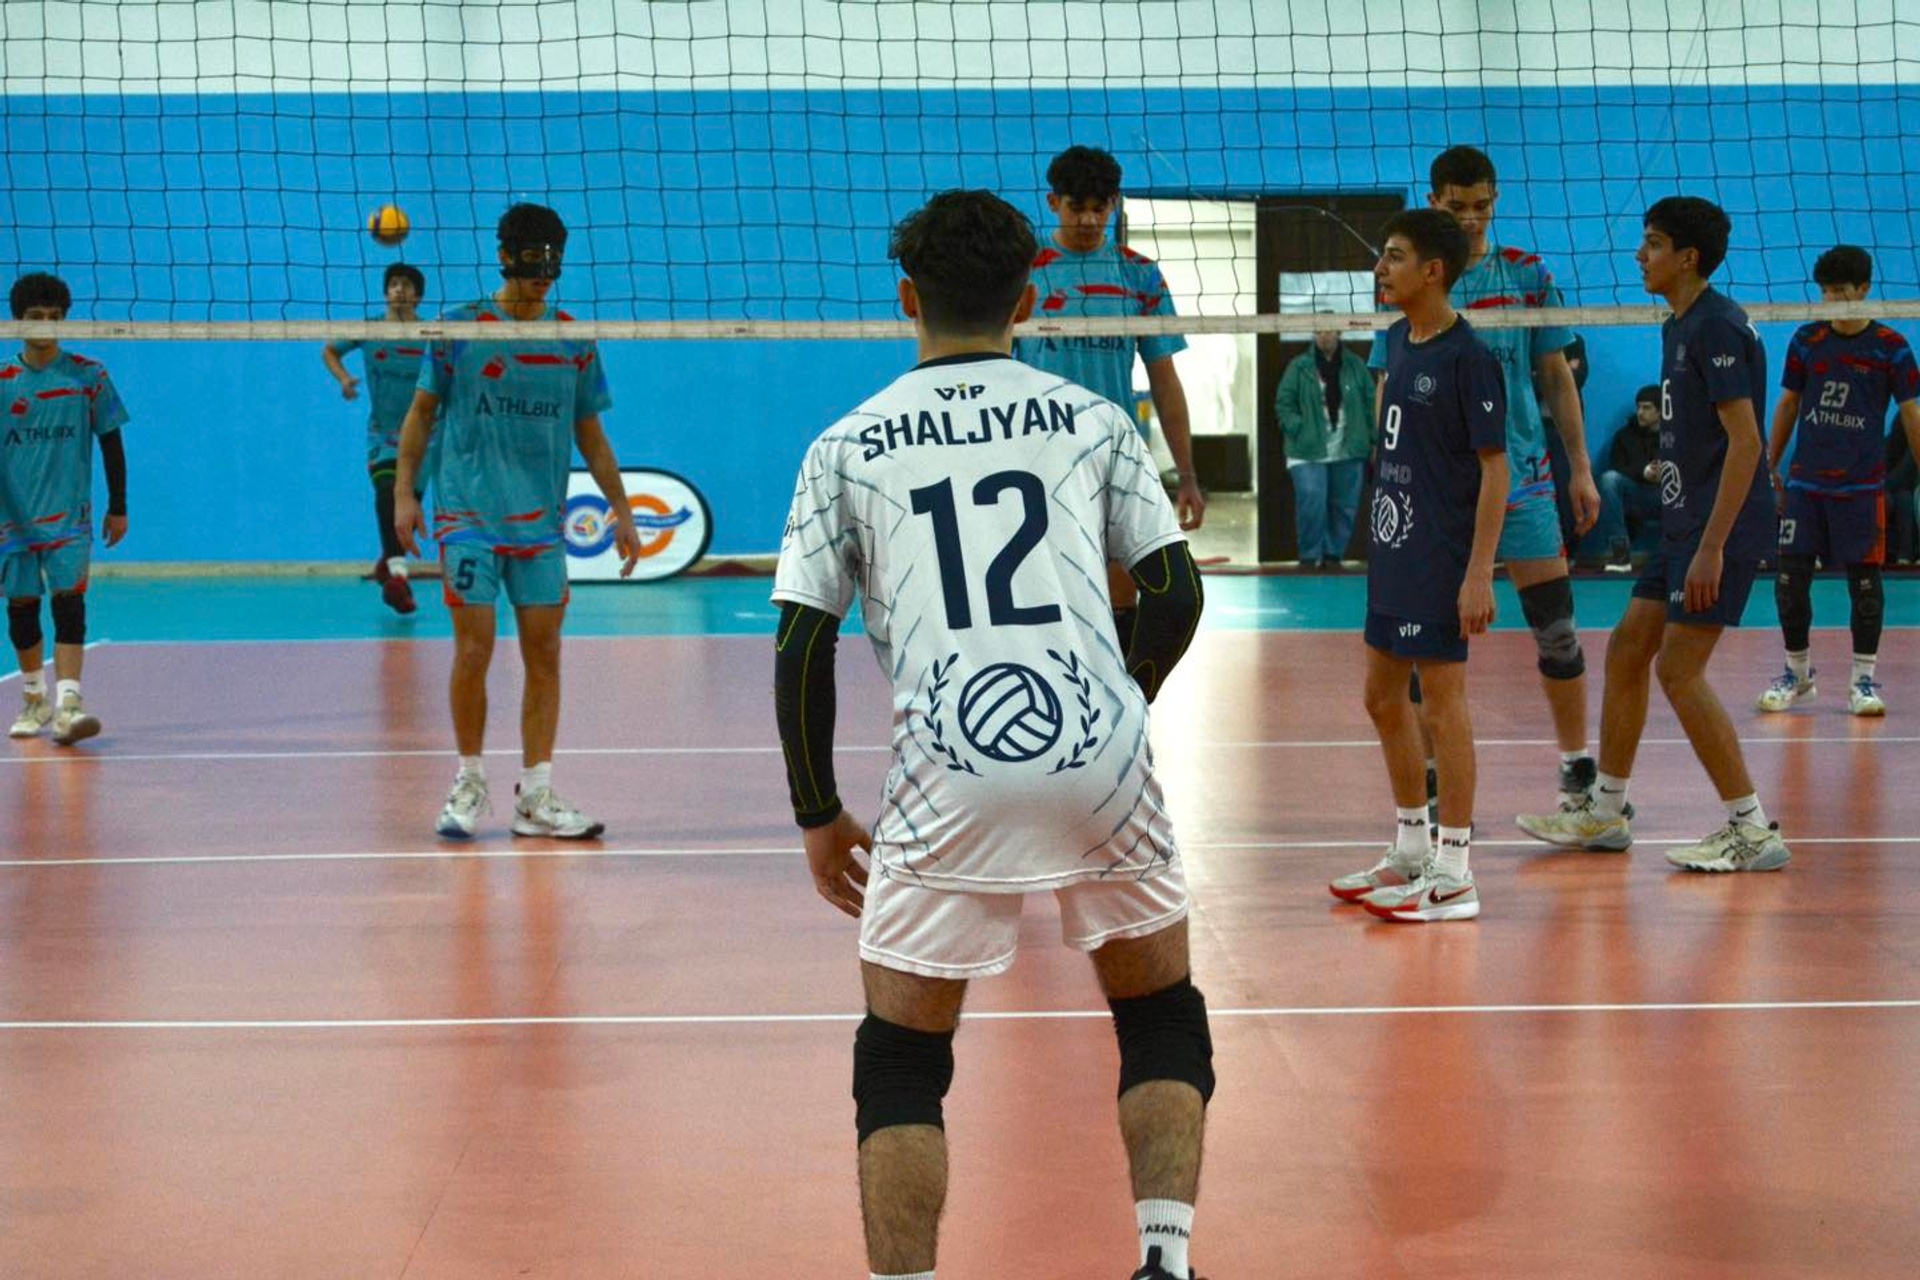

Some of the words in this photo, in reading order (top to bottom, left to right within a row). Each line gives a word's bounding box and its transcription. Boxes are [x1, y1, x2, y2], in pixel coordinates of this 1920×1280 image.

[1661, 378, 1674, 421] 6
[1819, 380, 1851, 408] 23
[859, 397, 1077, 462] SHALJYAN
[1384, 404, 1402, 450] 9
[909, 469, 1063, 630] 12
[455, 557, 477, 591] 5
